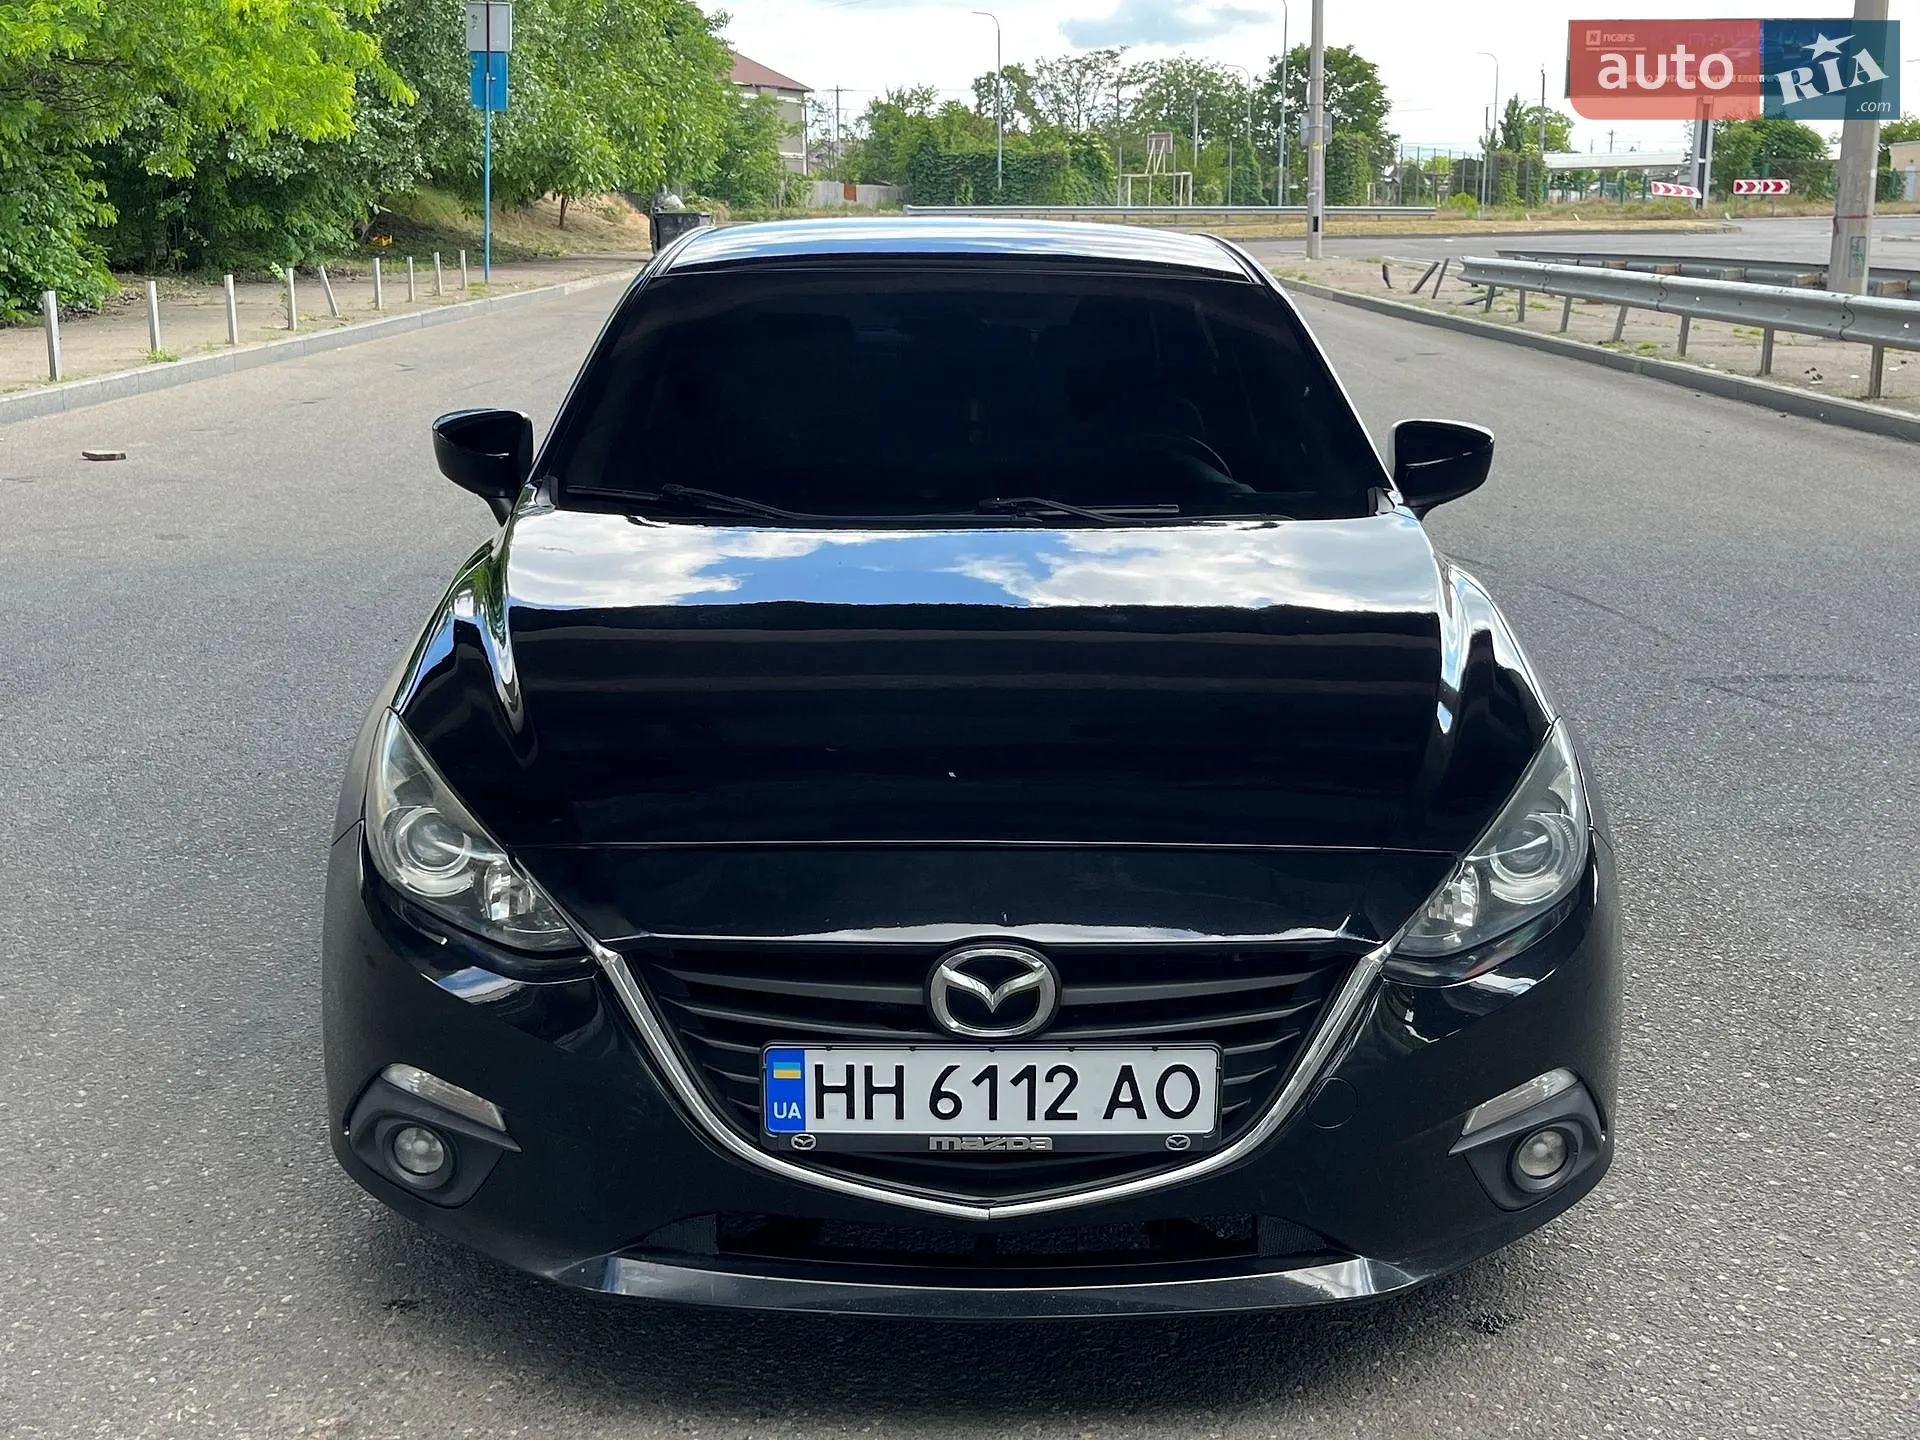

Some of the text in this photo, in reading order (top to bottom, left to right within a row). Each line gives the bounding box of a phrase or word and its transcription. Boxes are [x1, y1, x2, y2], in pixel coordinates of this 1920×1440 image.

[1603, 33, 1636, 43] ncars
[814, 1063, 1201, 1121] HH 6112 AO
[773, 1101, 802, 1119] UA
